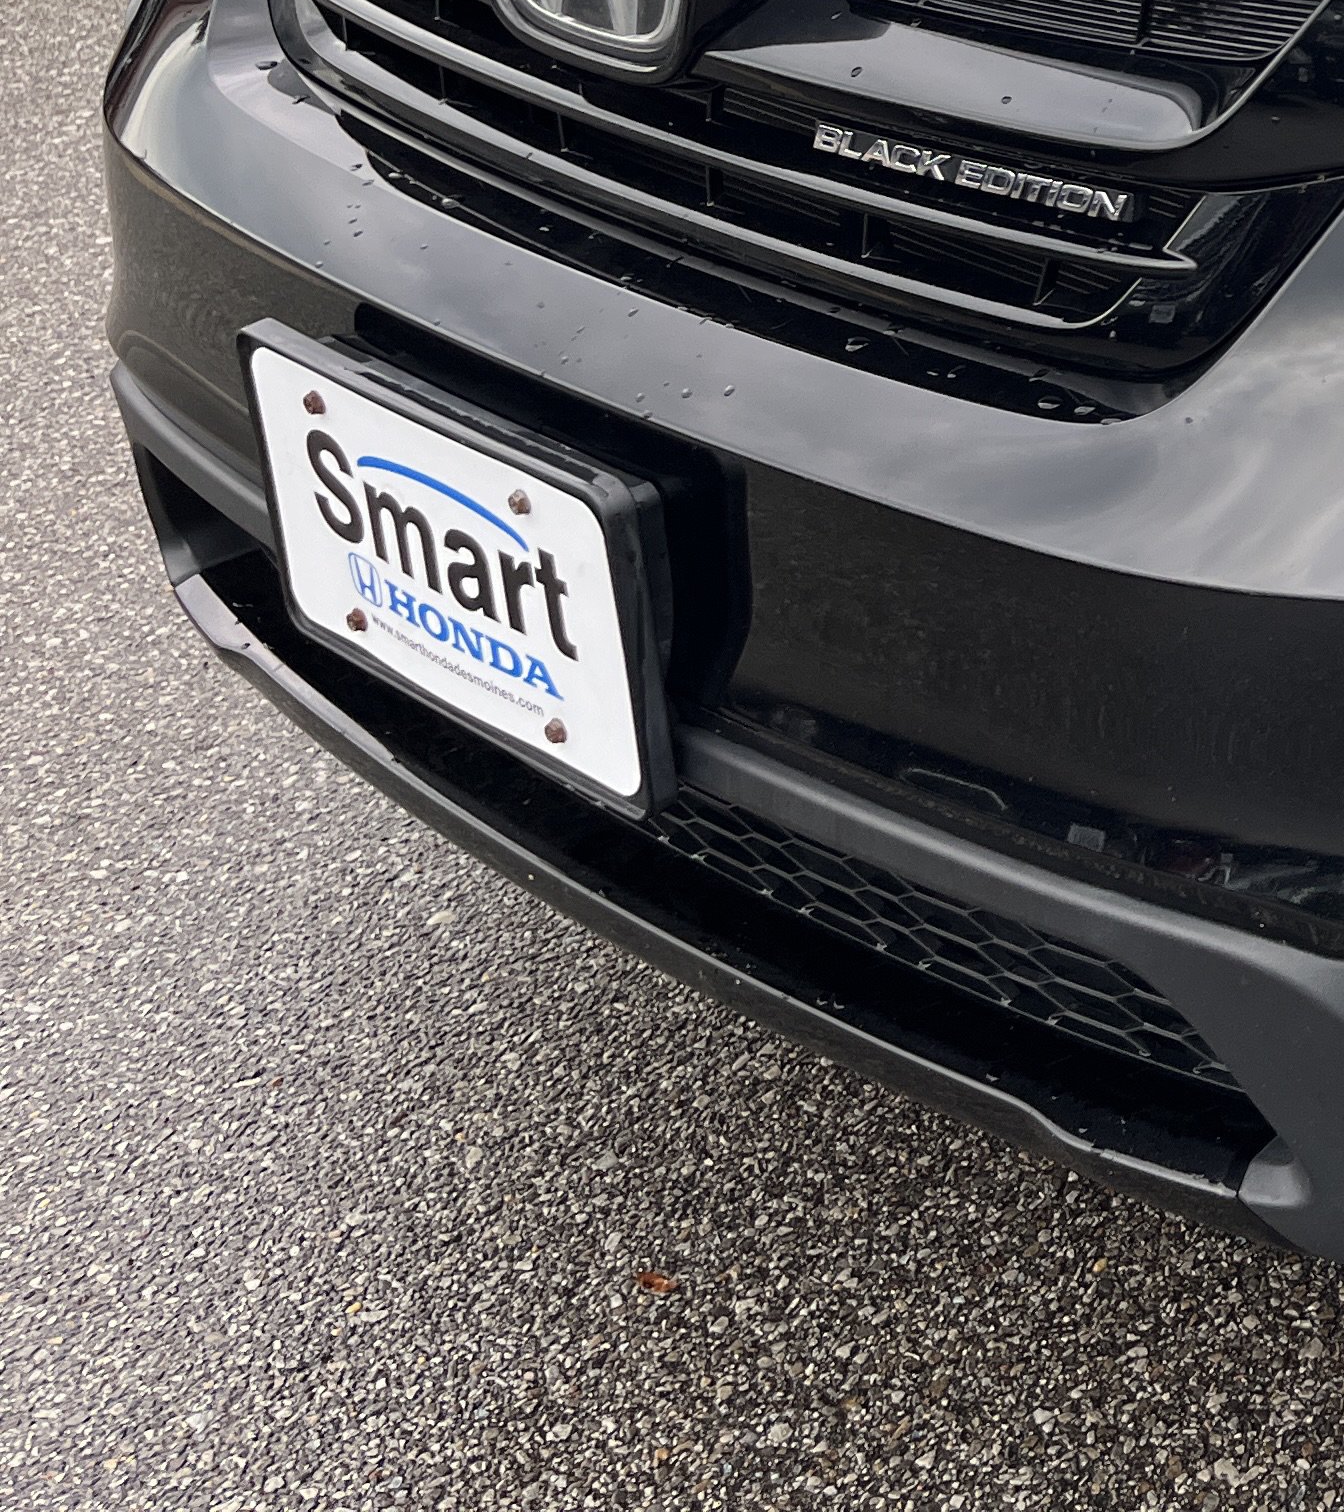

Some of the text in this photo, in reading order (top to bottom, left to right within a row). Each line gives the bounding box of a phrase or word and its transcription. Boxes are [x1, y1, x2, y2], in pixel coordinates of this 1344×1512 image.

[812, 122, 1130, 222] BLACK EDITION
[305, 429, 580, 662] Smart
[384, 578, 565, 702] HONDA
